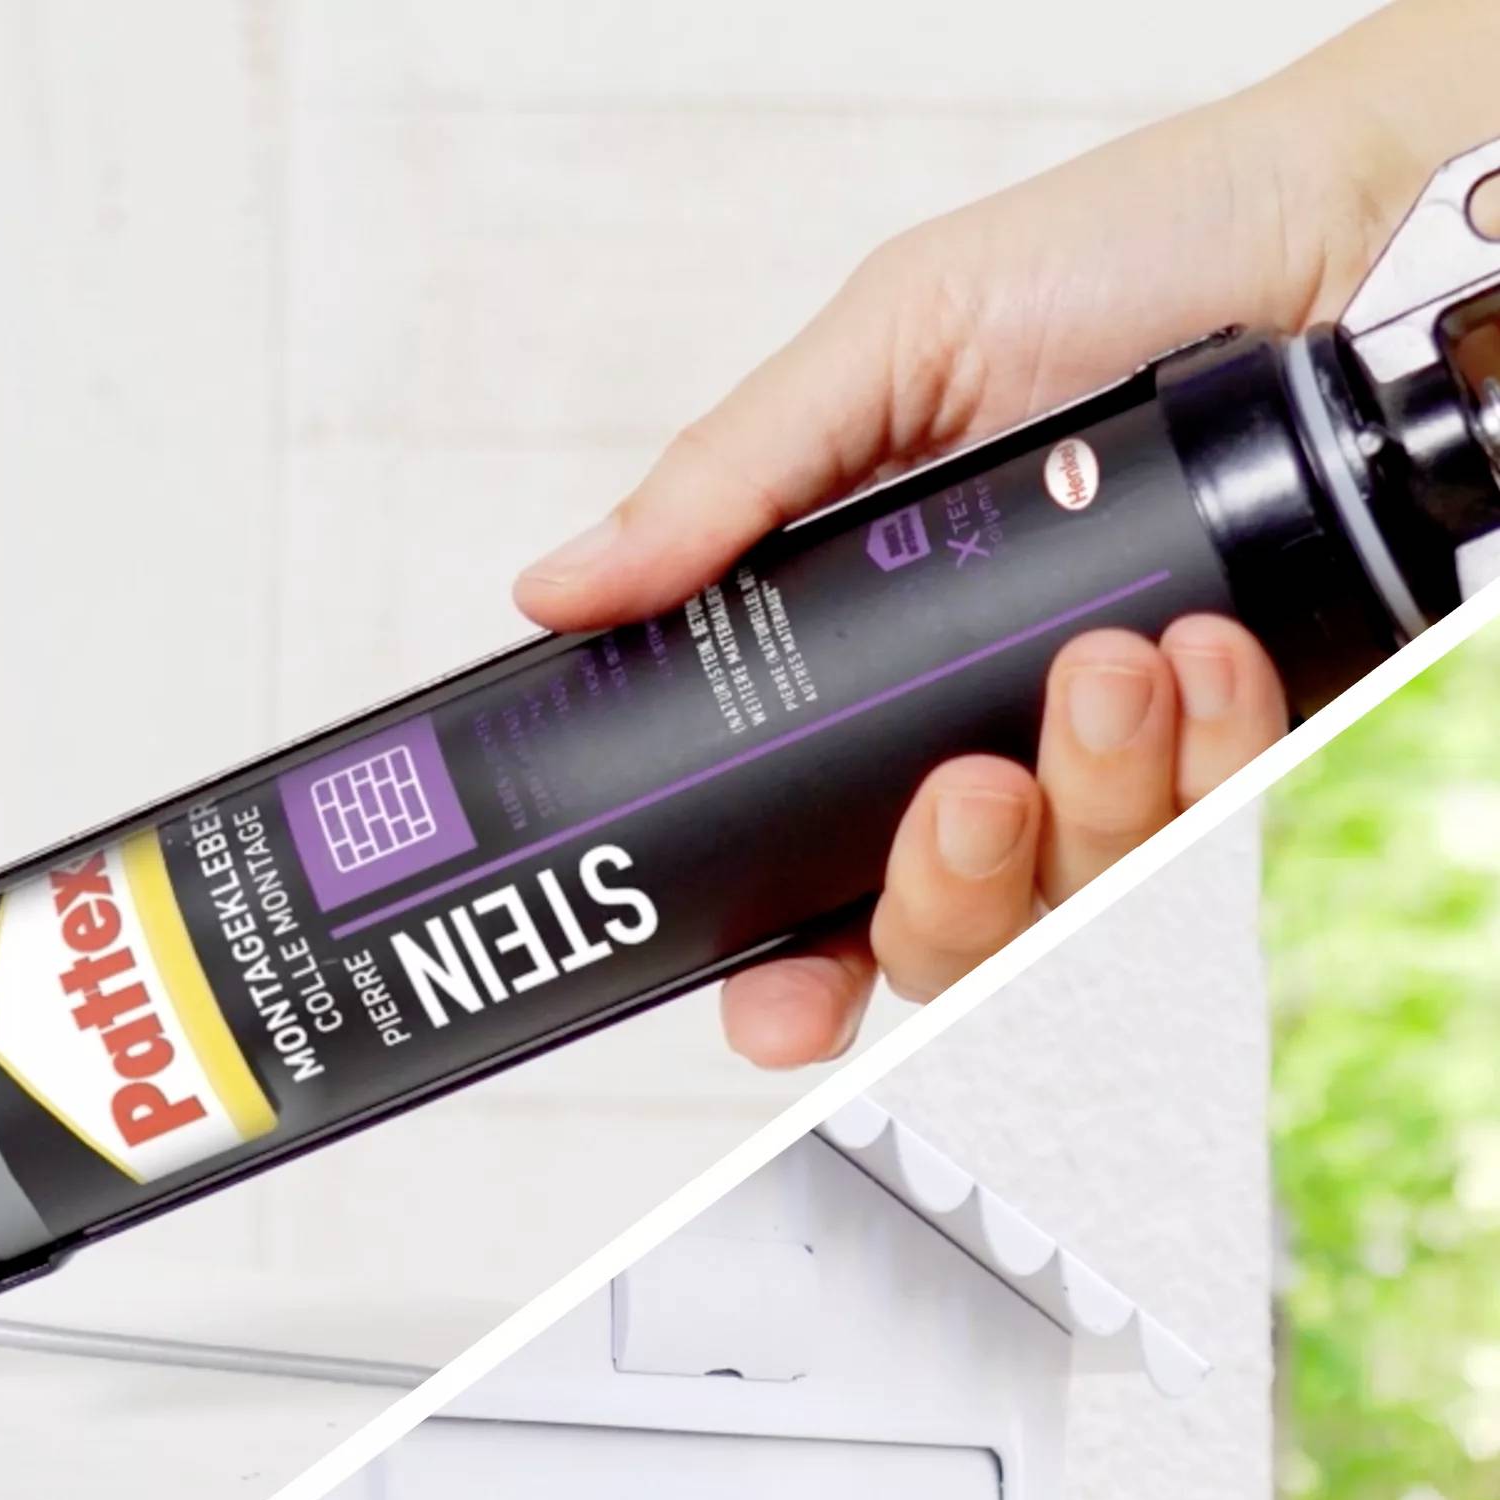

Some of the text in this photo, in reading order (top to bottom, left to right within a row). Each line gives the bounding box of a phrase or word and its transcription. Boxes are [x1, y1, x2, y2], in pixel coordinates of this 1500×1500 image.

[1055, 440, 1088, 505] Henkel
[730, 664, 766, 727] WEITERE
[770, 664, 799, 711] PIERRE
[787, 652, 818, 702] AUTRES
[188, 798, 325, 1083] MONTAGEKLEBER
[233, 805, 343, 1033] COLLE MONTAGE
[390, 844, 658, 1029] STEIN
[49, 848, 208, 1147] Pattex
[343, 949, 411, 1046] PIERRE
